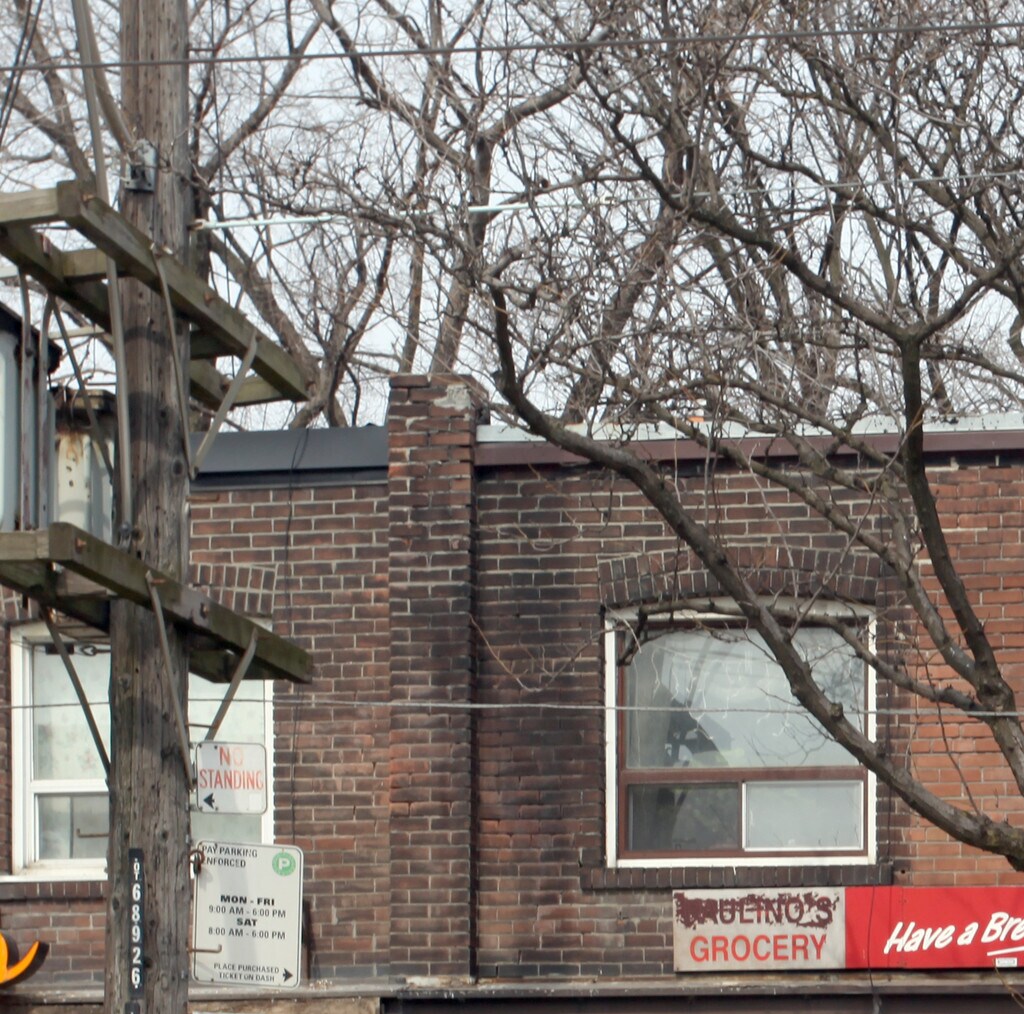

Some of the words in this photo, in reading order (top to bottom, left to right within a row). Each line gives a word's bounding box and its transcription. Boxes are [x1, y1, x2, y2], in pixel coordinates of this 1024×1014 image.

[219, 746, 243, 767] NO
[199, 769, 264, 790] STANDING
[202, 845, 218, 854] PAY
[219, 847, 258, 858] PARKING
[204, 857, 247, 868] NFORCED
[220, 895, 247, 904] MON
[257, 897, 275, 906] FRI
[208, 904, 226, 914] 9:00
[229, 906, 244, 915] AM
[252, 908, 270, 917] 6:00
[272, 909, 286, 918] PM
[236, 918, 257, 927] SAT
[208, 926, 226, 936] 8:00
[228, 928, 243, 937] AM
[252, 930, 269, 939] 6:00
[271, 931, 286, 940] PM
[883, 921, 956, 954] Have
[957, 922, 979, 945] a
[690, 934, 827, 962] GROCERY
[213, 963, 235, 971] PLACE
[238, 964, 279, 974] PURCHASED
[219, 971, 242, 980] TICKET
[244, 972, 254, 980] ON
[256, 972, 275, 982] DASH
